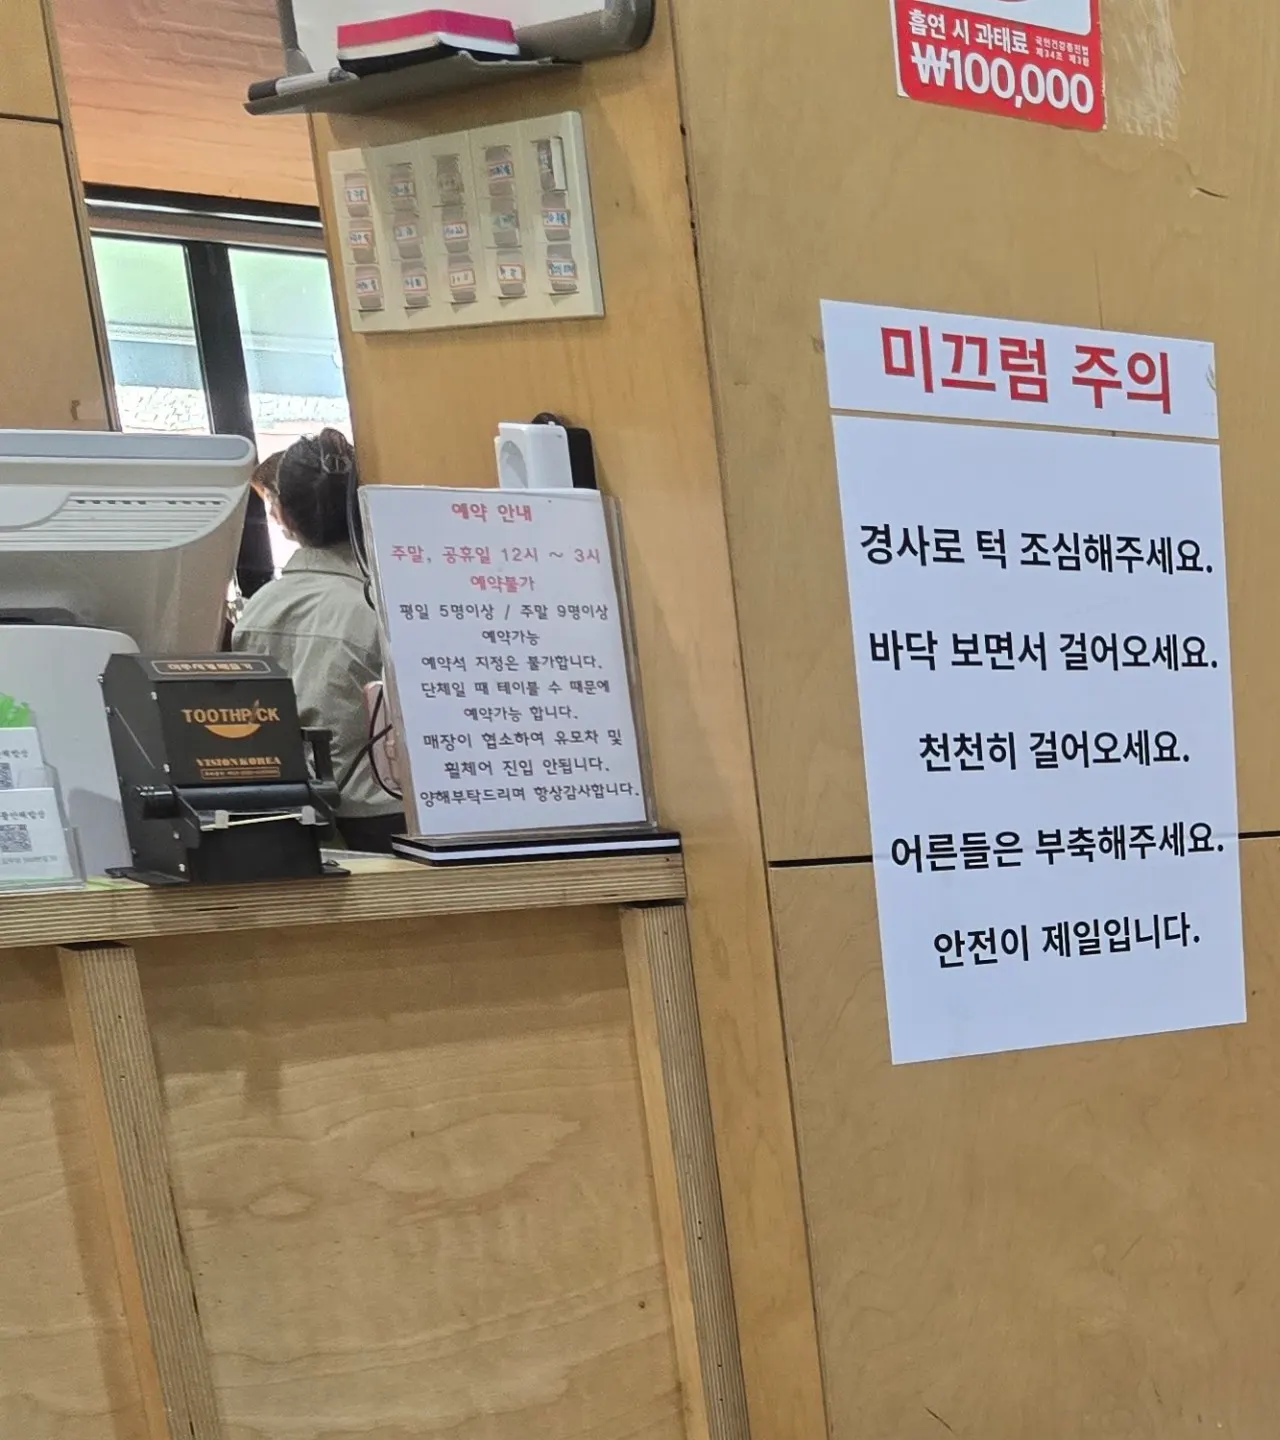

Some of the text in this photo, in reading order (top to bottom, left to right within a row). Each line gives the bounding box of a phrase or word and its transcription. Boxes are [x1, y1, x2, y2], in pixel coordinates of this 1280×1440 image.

[908, 8, 1029, 54] 흡연 시 과태료
[880, 325, 1171, 415] 미끄럼 주의
[451, 502, 533, 523] 예약 안내
[391, 545, 432, 564] 주말,
[442, 545, 491, 565] 공휴일
[500, 546, 539, 563] 12시
[574, 548, 601, 564] 3시
[860, 523, 1213, 575] 경사로 턱 조심해주세요.
[469, 575, 535, 594] 예약불가
[399, 603, 609, 621] 평일 5명이상 / 주말 9명이상
[481, 629, 541, 647] 예약가능
[869, 629, 1218, 672] 바닥 보면서 걸어오세요.
[421, 655, 603, 673] 예약석 지정은 불가합니다.
[420, 679, 610, 699] 단체일 때 테이블 수 때문에
[463, 705, 579, 723] 예약가능 합니다.
[422, 728, 623, 752] 매장이 협소하여 유모차 및
[919, 729, 1190, 773] 천천히 걸어오세요.
[444, 756, 610, 780] 휠체어 진입 안됩니다.
[419, 782, 640, 808] 양해부탁드리며 항상감사합니다.
[891, 821, 1224, 874] 어른들은 부축해주세요.
[933, 911, 1200, 969] 안전이 제일입니다.
